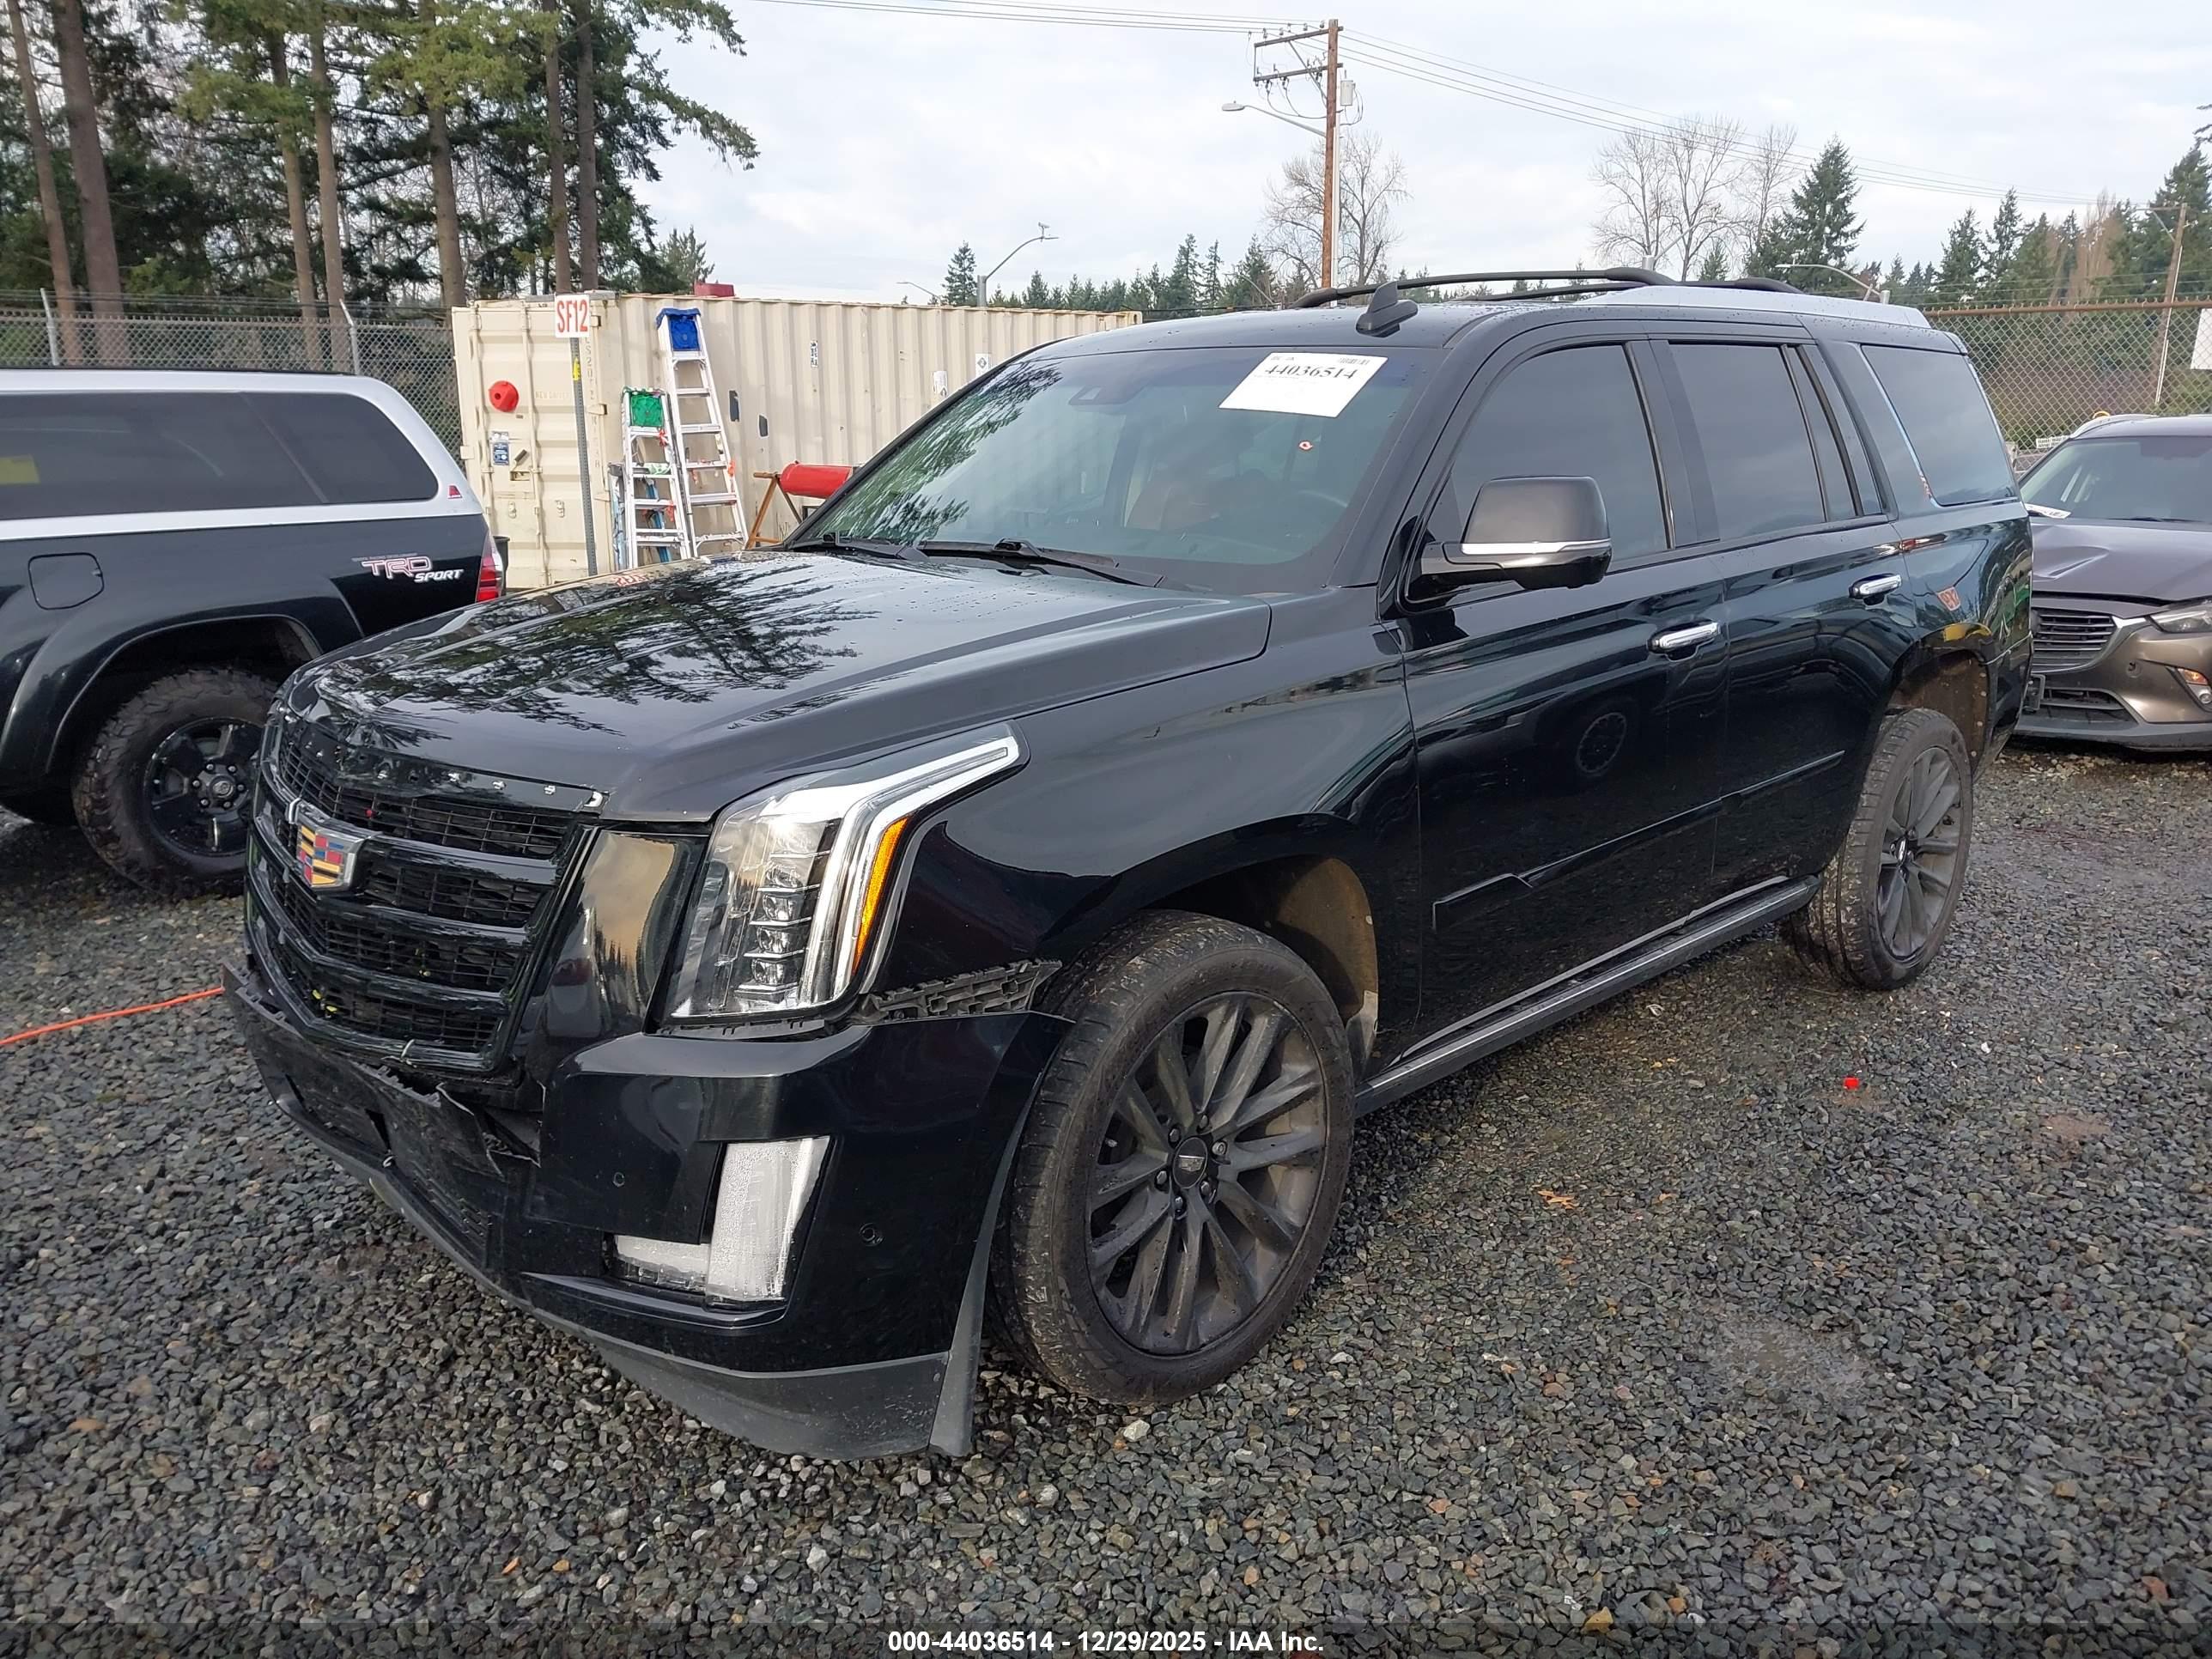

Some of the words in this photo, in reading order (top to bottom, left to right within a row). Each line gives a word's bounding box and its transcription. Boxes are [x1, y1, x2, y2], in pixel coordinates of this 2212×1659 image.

[556, 299, 588, 333] SF12
[1264, 364, 1359, 380] 44036514
[361, 556, 433, 580] TRD
[414, 568, 464, 583] SPORT
